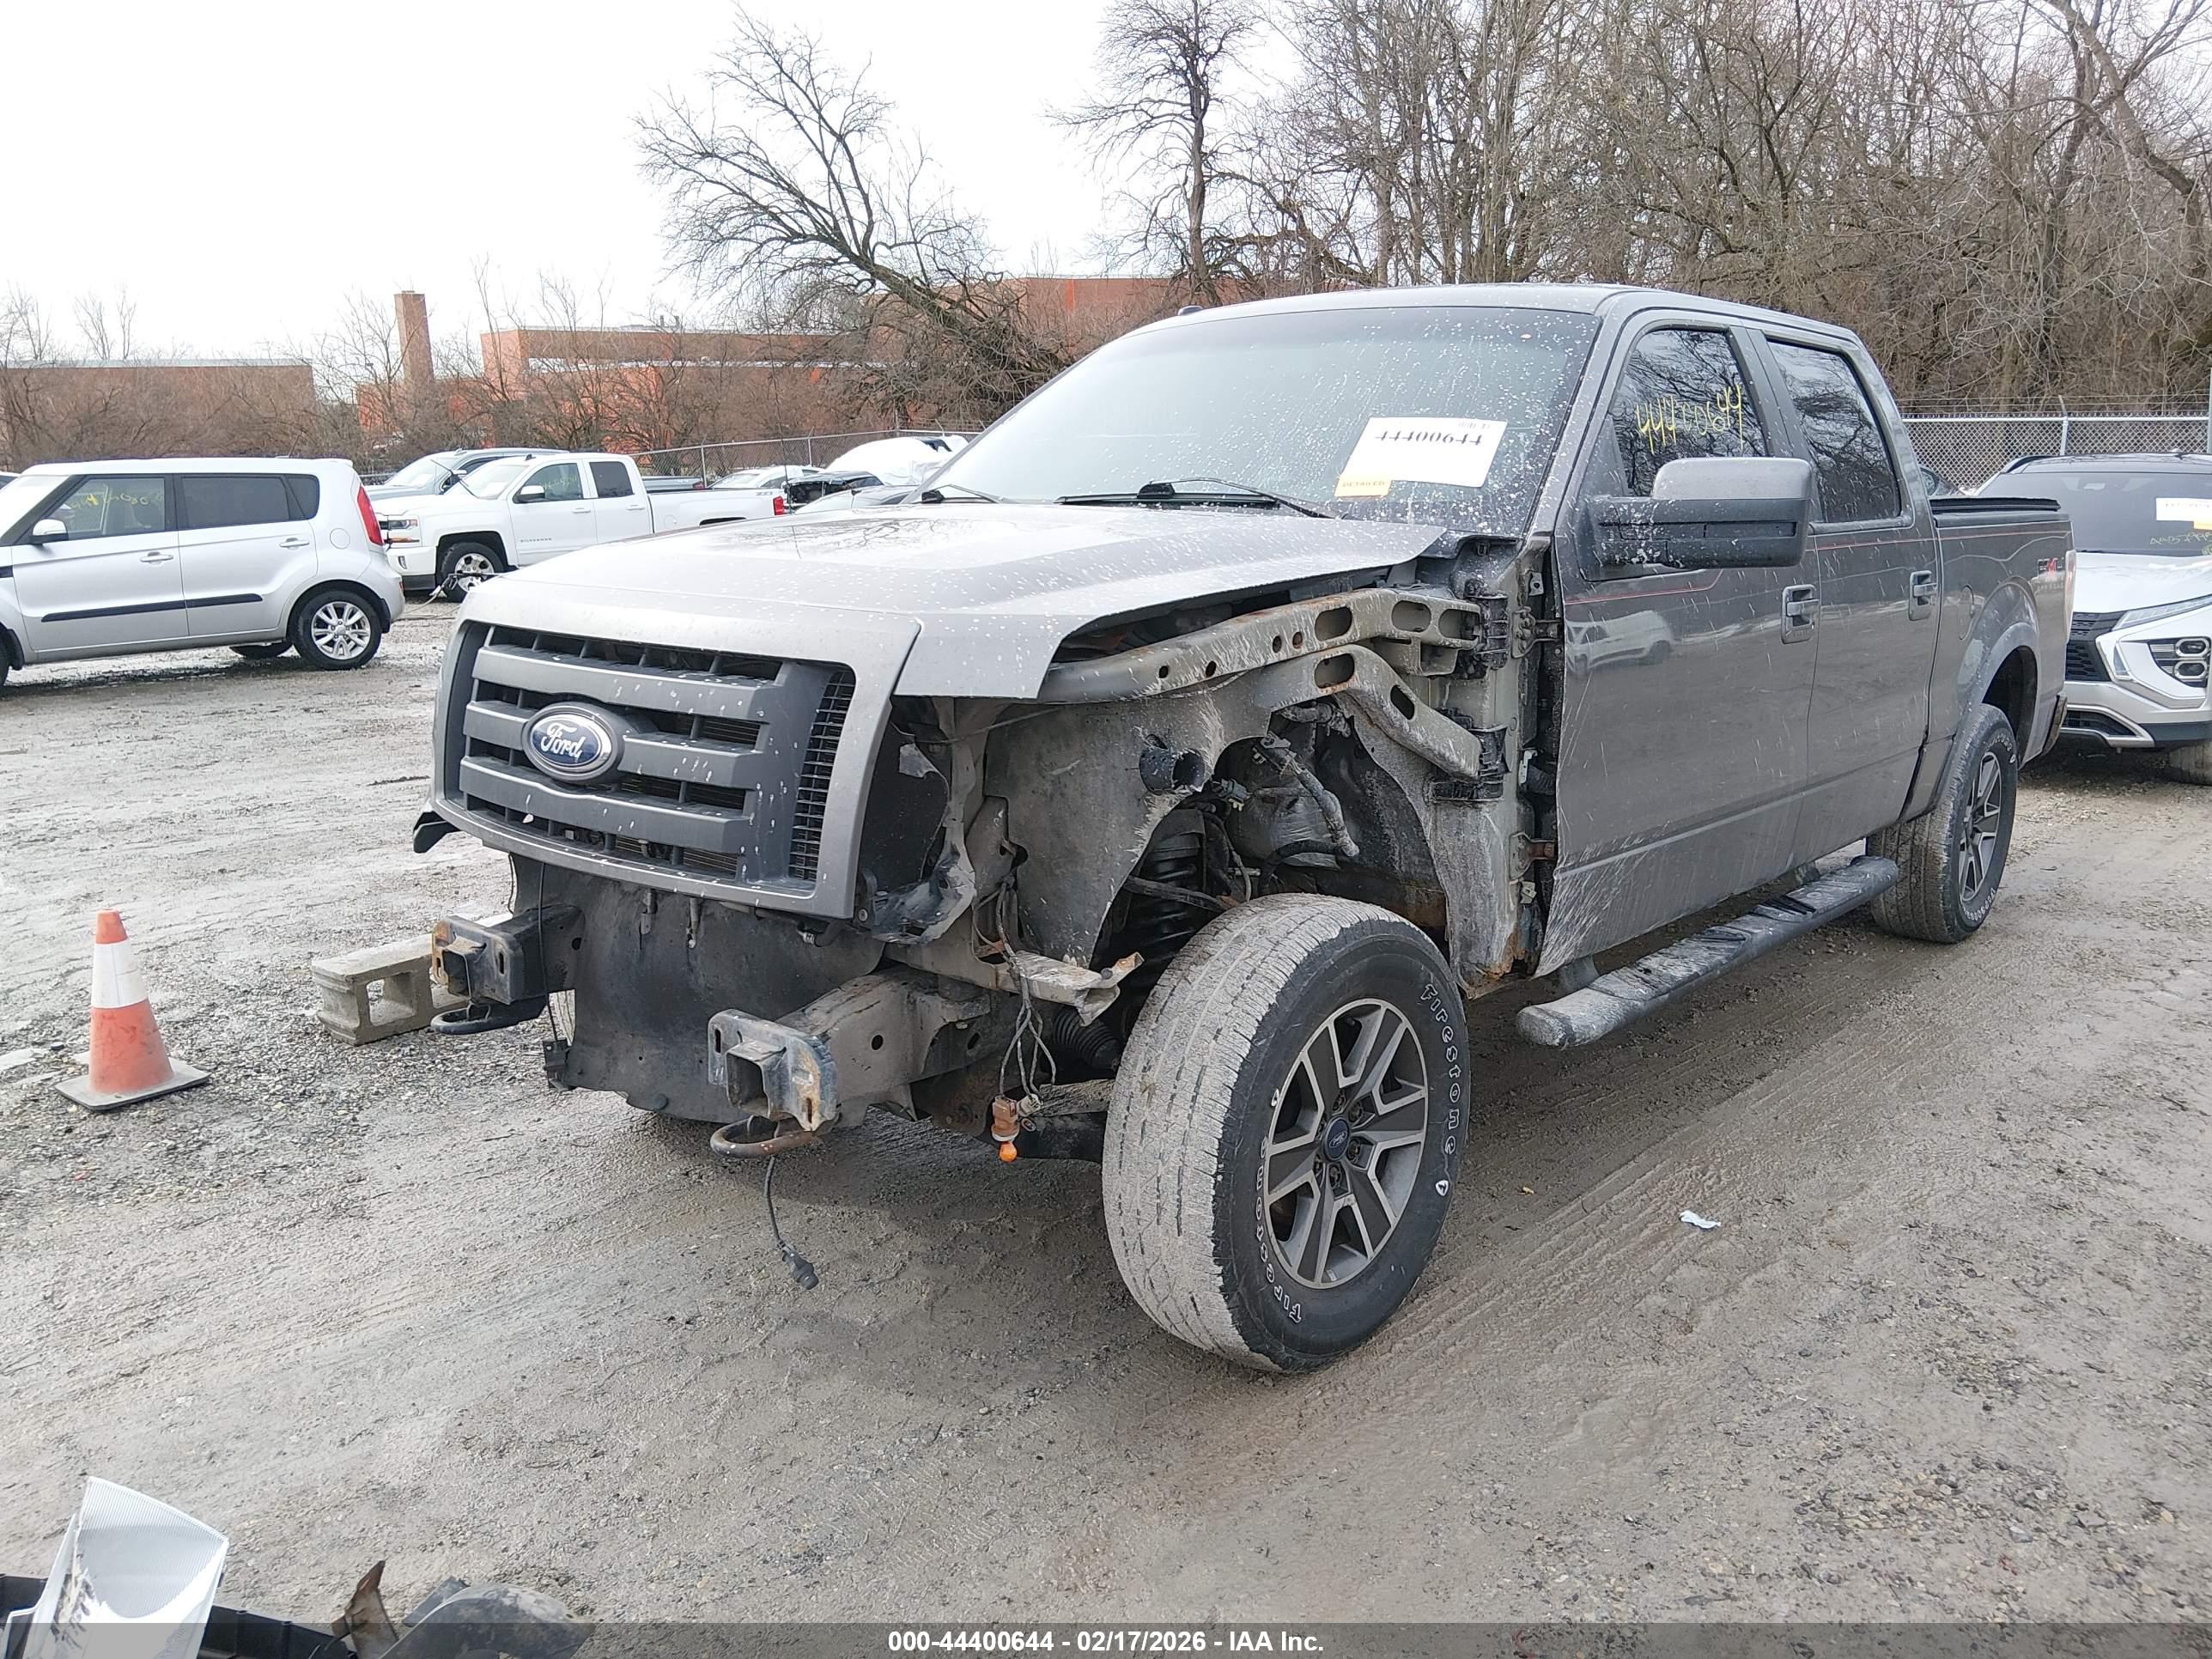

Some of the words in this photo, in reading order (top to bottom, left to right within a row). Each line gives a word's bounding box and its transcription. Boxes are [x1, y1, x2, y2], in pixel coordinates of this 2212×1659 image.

[1373, 430, 1483, 446] 44400644
[540, 722, 586, 763] Ford
[1420, 983, 1462, 1156] Firestone
[1255, 1135, 1303, 1323] Firestone
